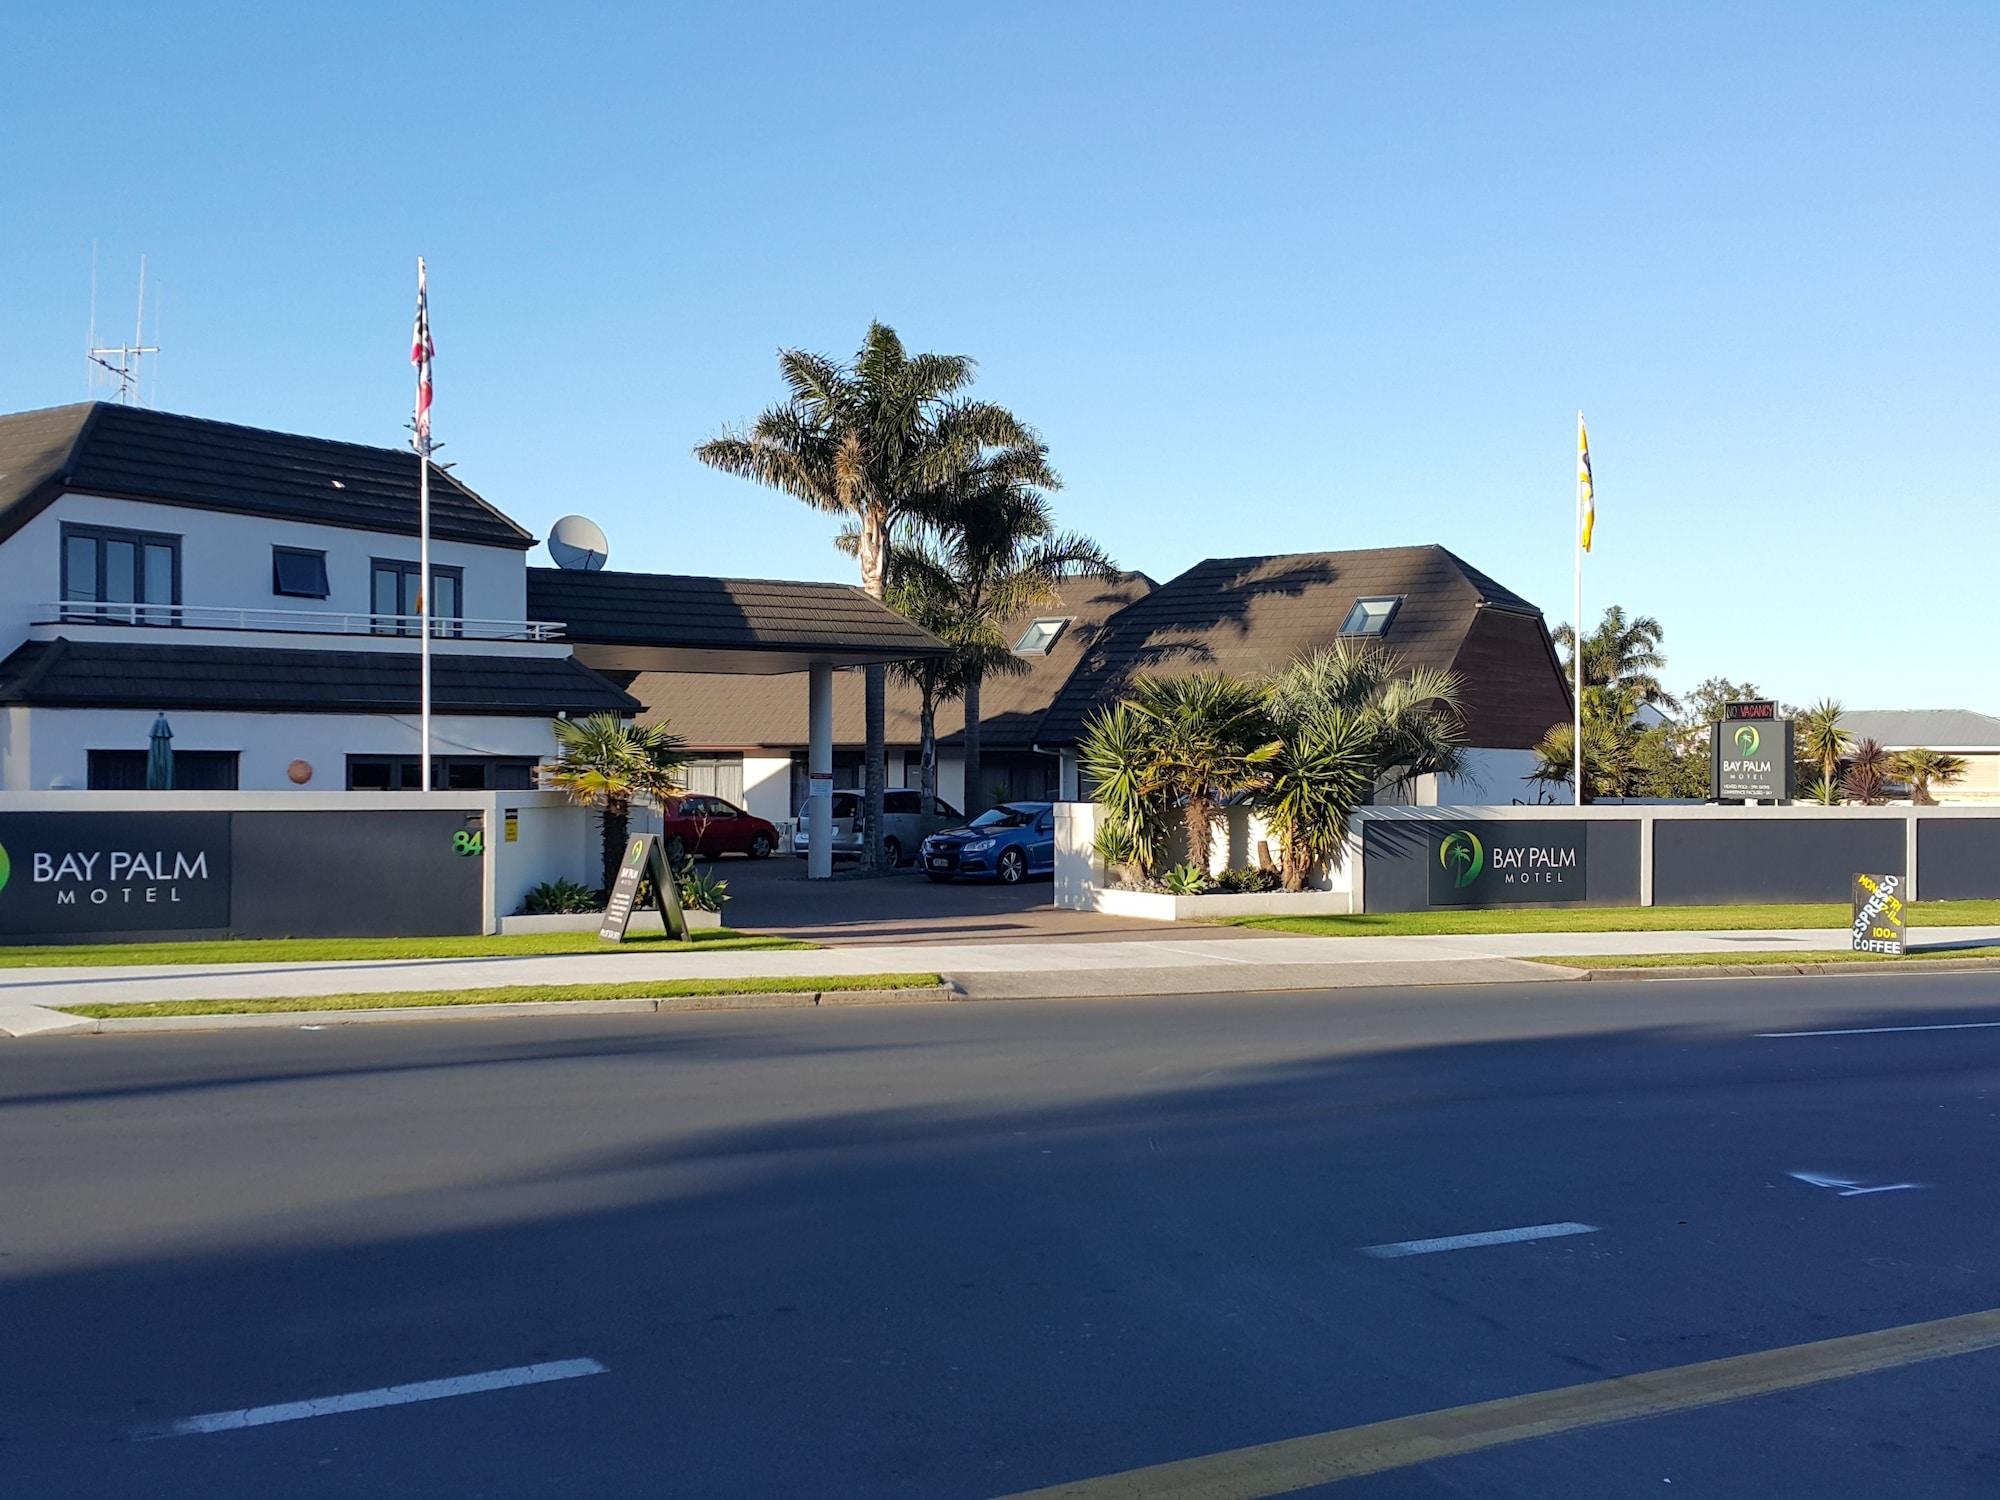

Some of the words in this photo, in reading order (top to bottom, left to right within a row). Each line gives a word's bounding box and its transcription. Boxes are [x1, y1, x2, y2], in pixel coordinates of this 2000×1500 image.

[1726, 705, 1738, 719] NO
[1740, 704, 1774, 718] VACANCY
[1723, 760, 1742, 772] BAY
[1743, 760, 1771, 772] PALM
[452, 830, 483, 855] 84
[33, 851, 100, 882] BAY
[110, 851, 208, 881] PALM
[1493, 847, 1526, 869] BAY
[1529, 847, 1576, 868] PALM
[1505, 872, 1563, 883] MOTEL
[57, 887, 181, 905] MOTEL
[1852, 875, 1899, 939] ESPRESSO
[1853, 940, 1901, 954] COFFEE
